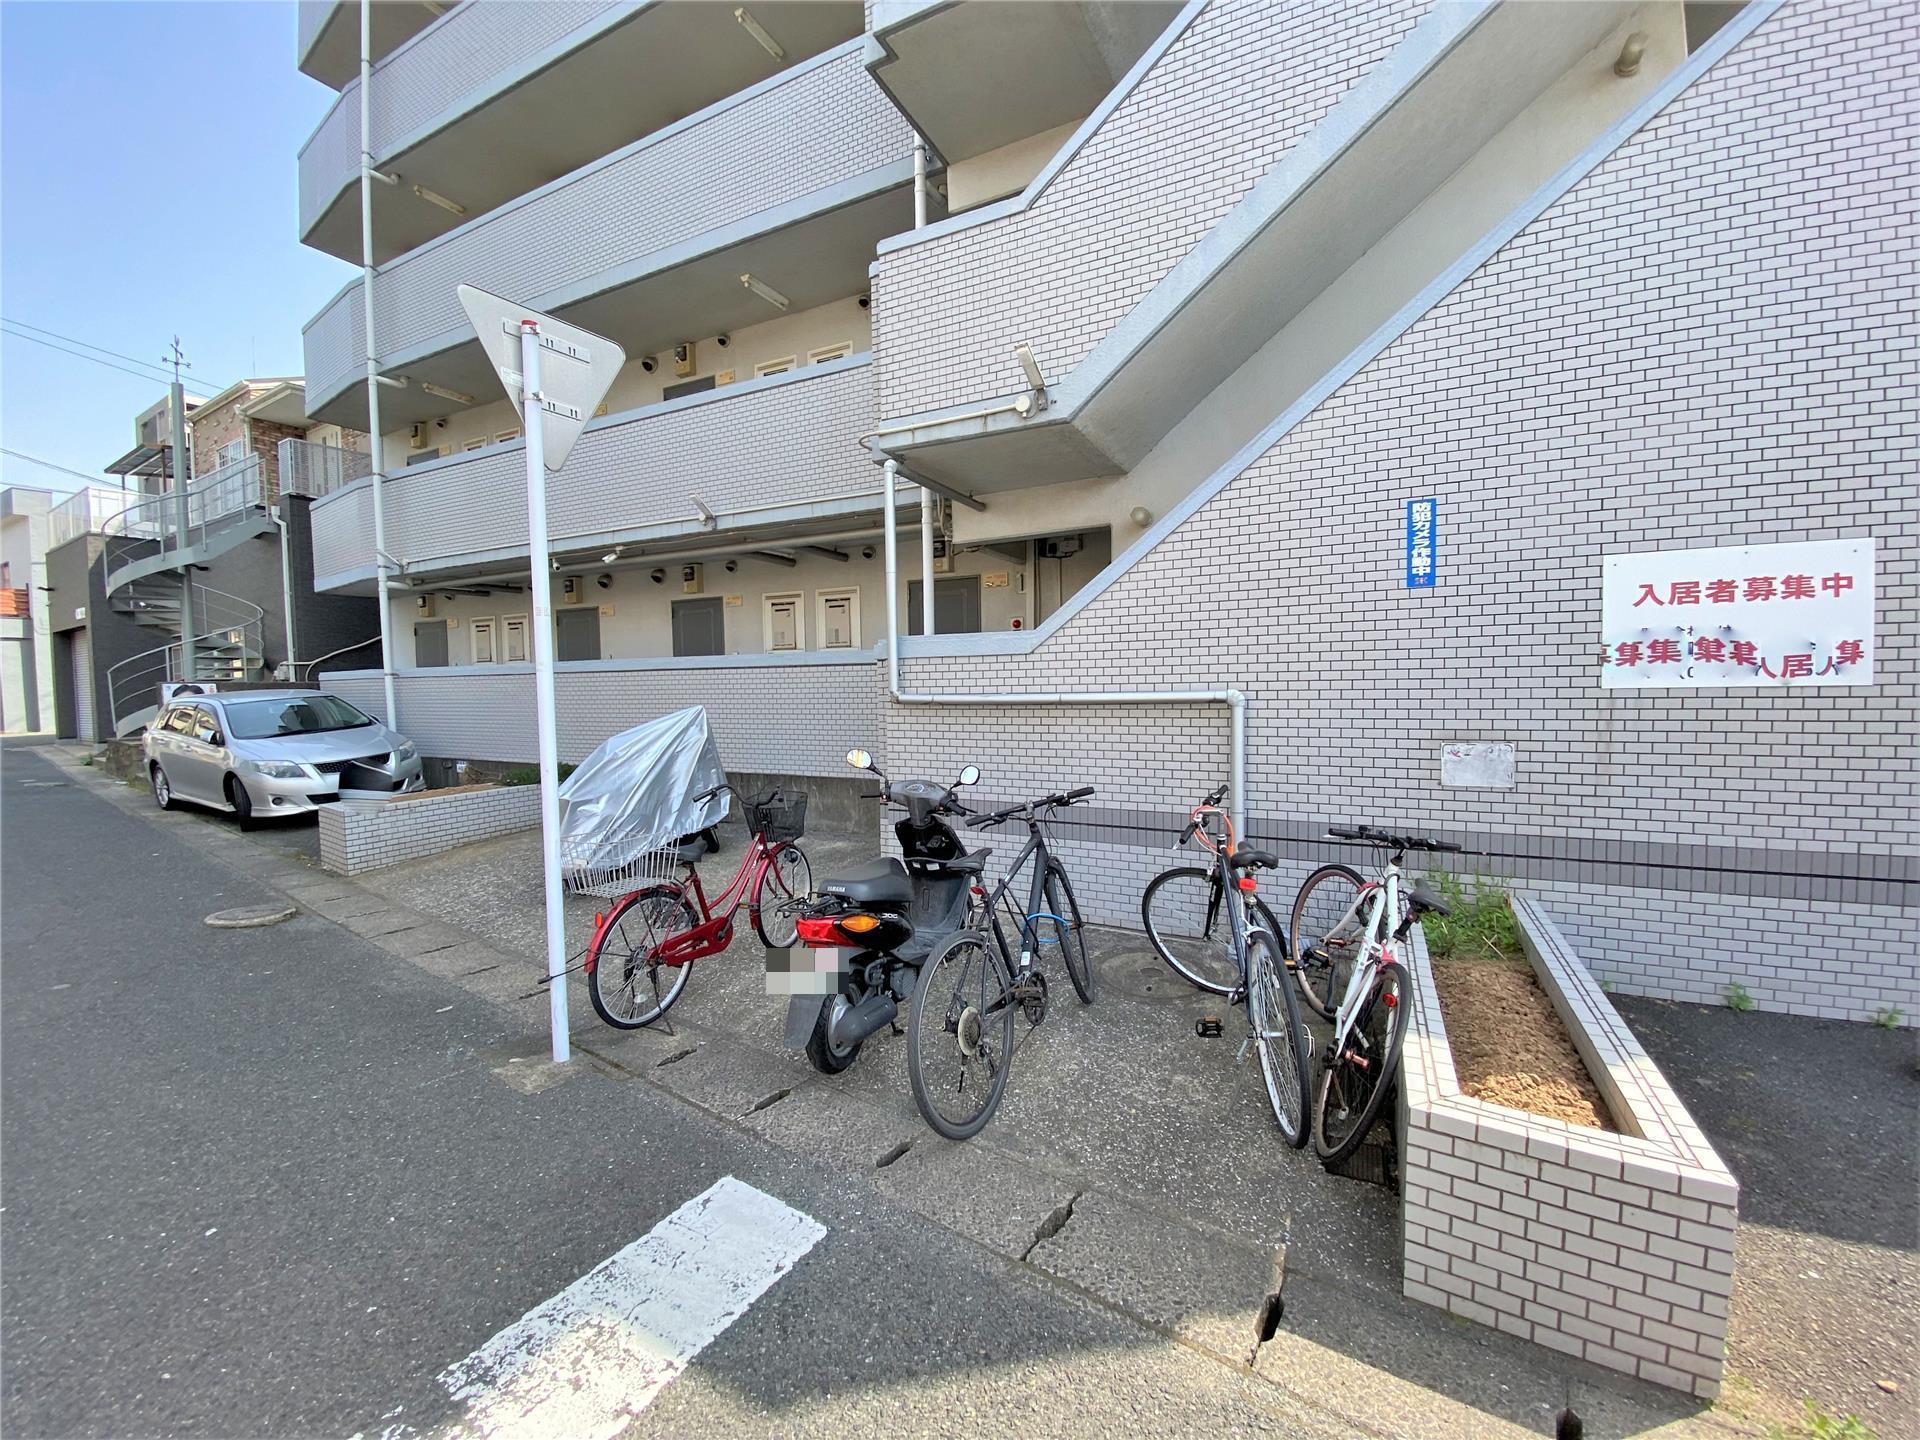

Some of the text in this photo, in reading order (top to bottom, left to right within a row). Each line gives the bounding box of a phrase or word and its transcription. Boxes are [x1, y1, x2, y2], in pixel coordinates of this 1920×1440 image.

[1411, 502, 1432, 576] 防犯カメラ作動中
[1632, 572, 1854, 608] 入居者募集中
